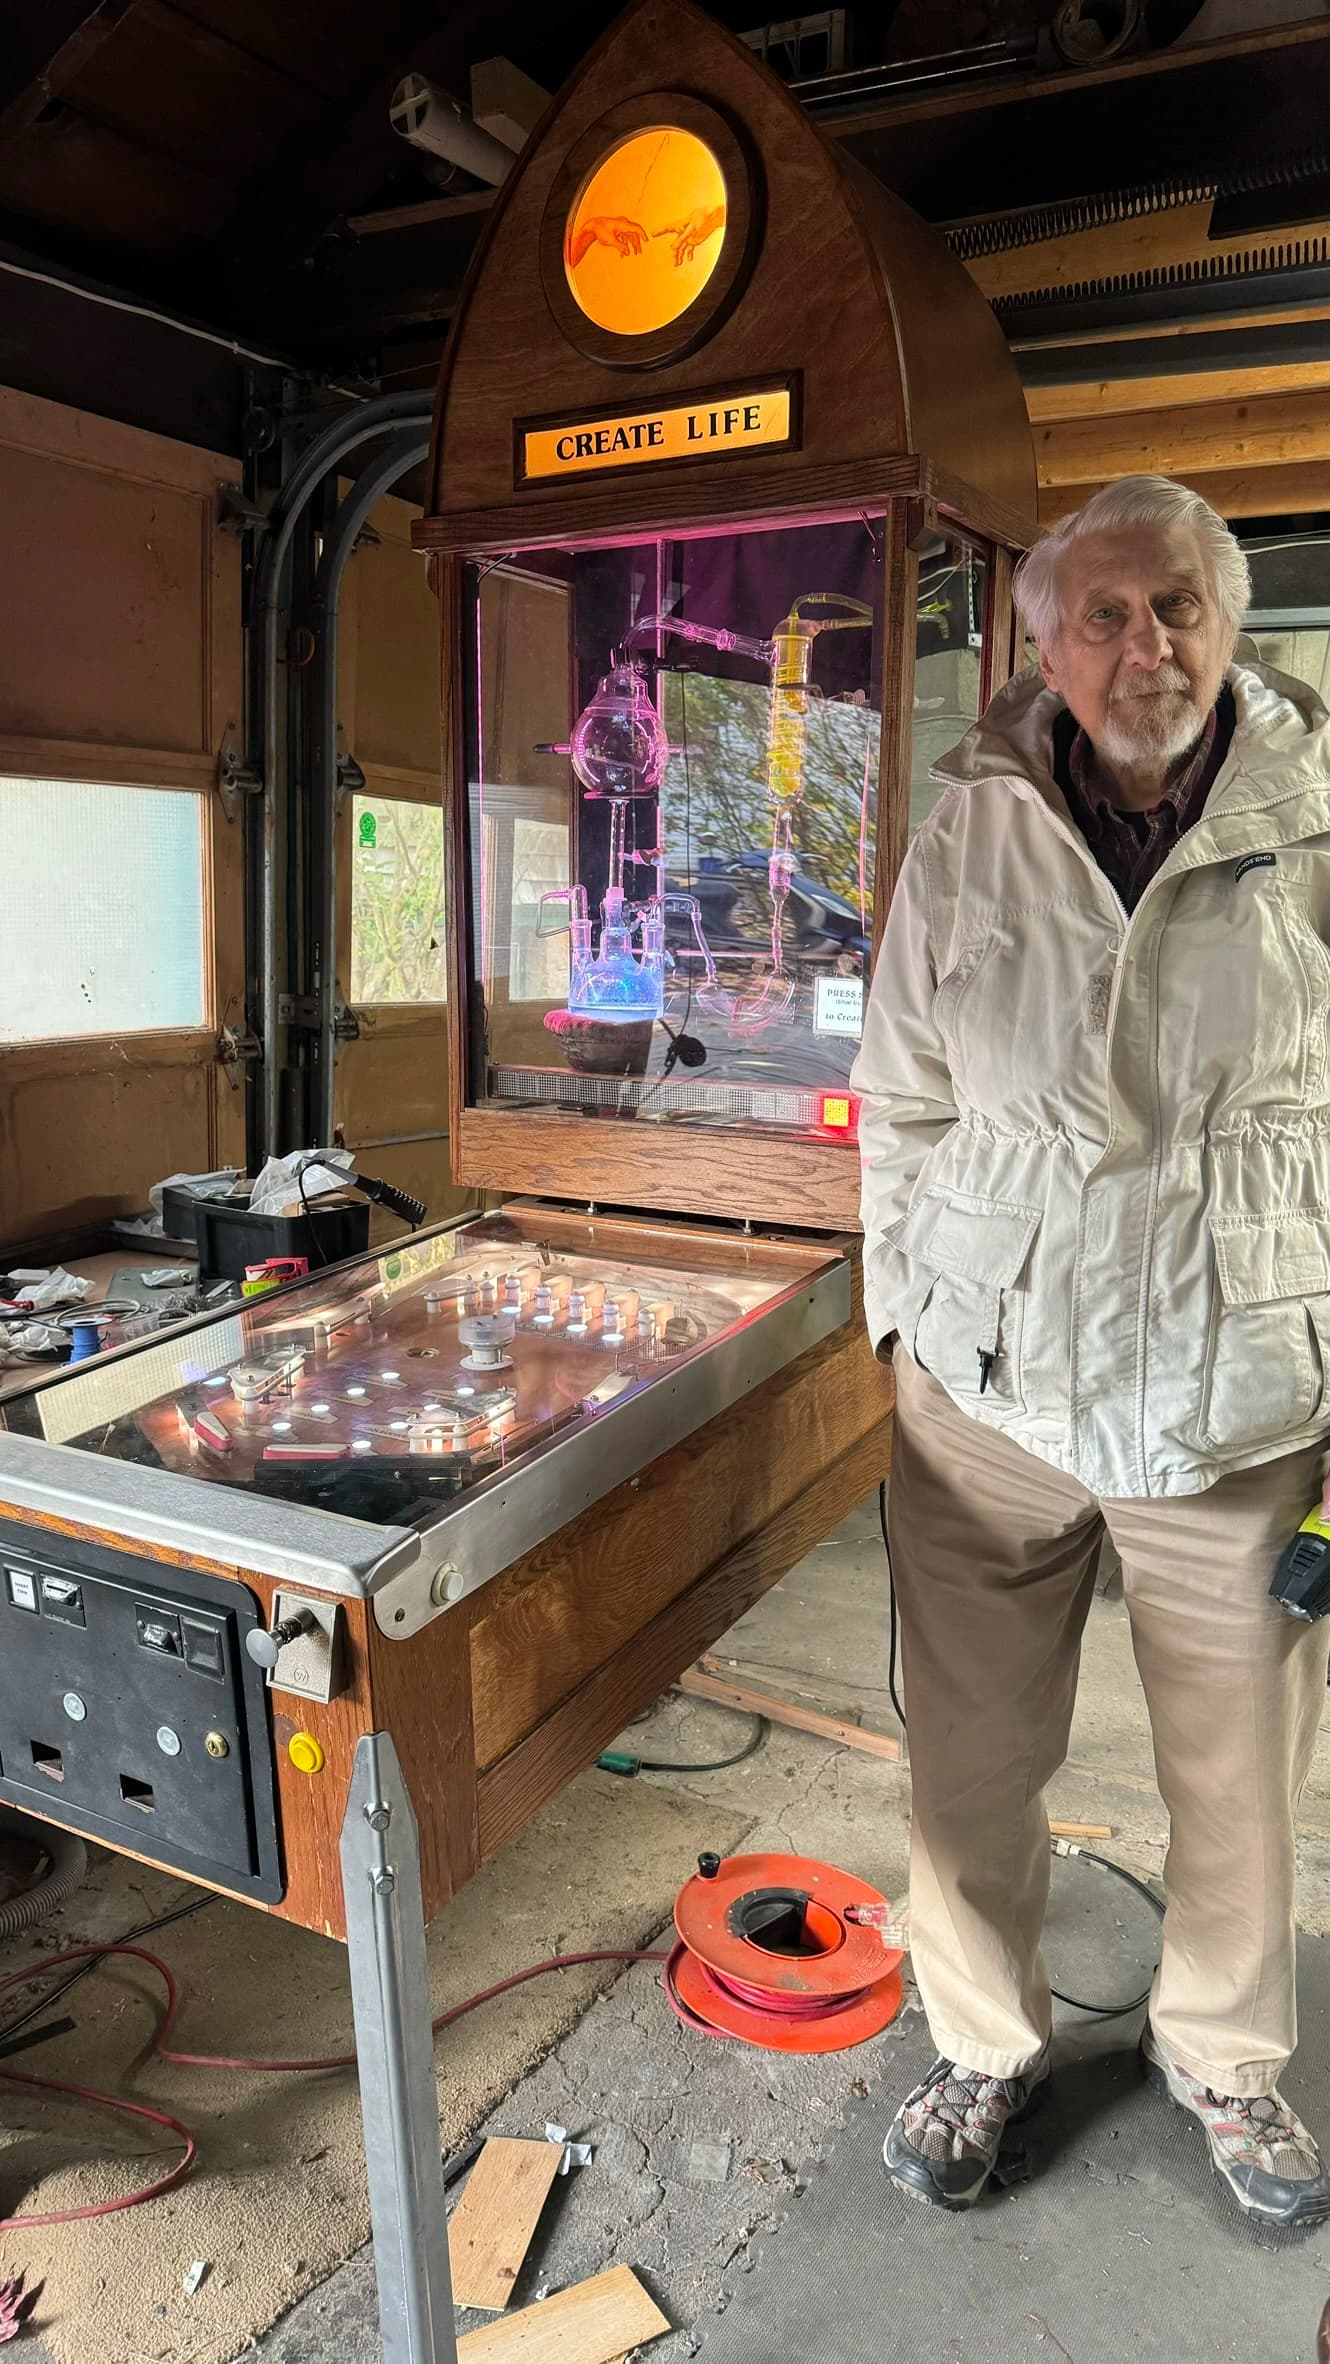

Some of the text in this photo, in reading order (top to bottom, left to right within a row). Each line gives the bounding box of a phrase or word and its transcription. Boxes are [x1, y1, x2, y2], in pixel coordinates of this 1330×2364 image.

[556, 405, 761, 461] CREATE LIFE
[827, 989, 856, 998] PRESS
[825, 1012, 835, 1020] to
